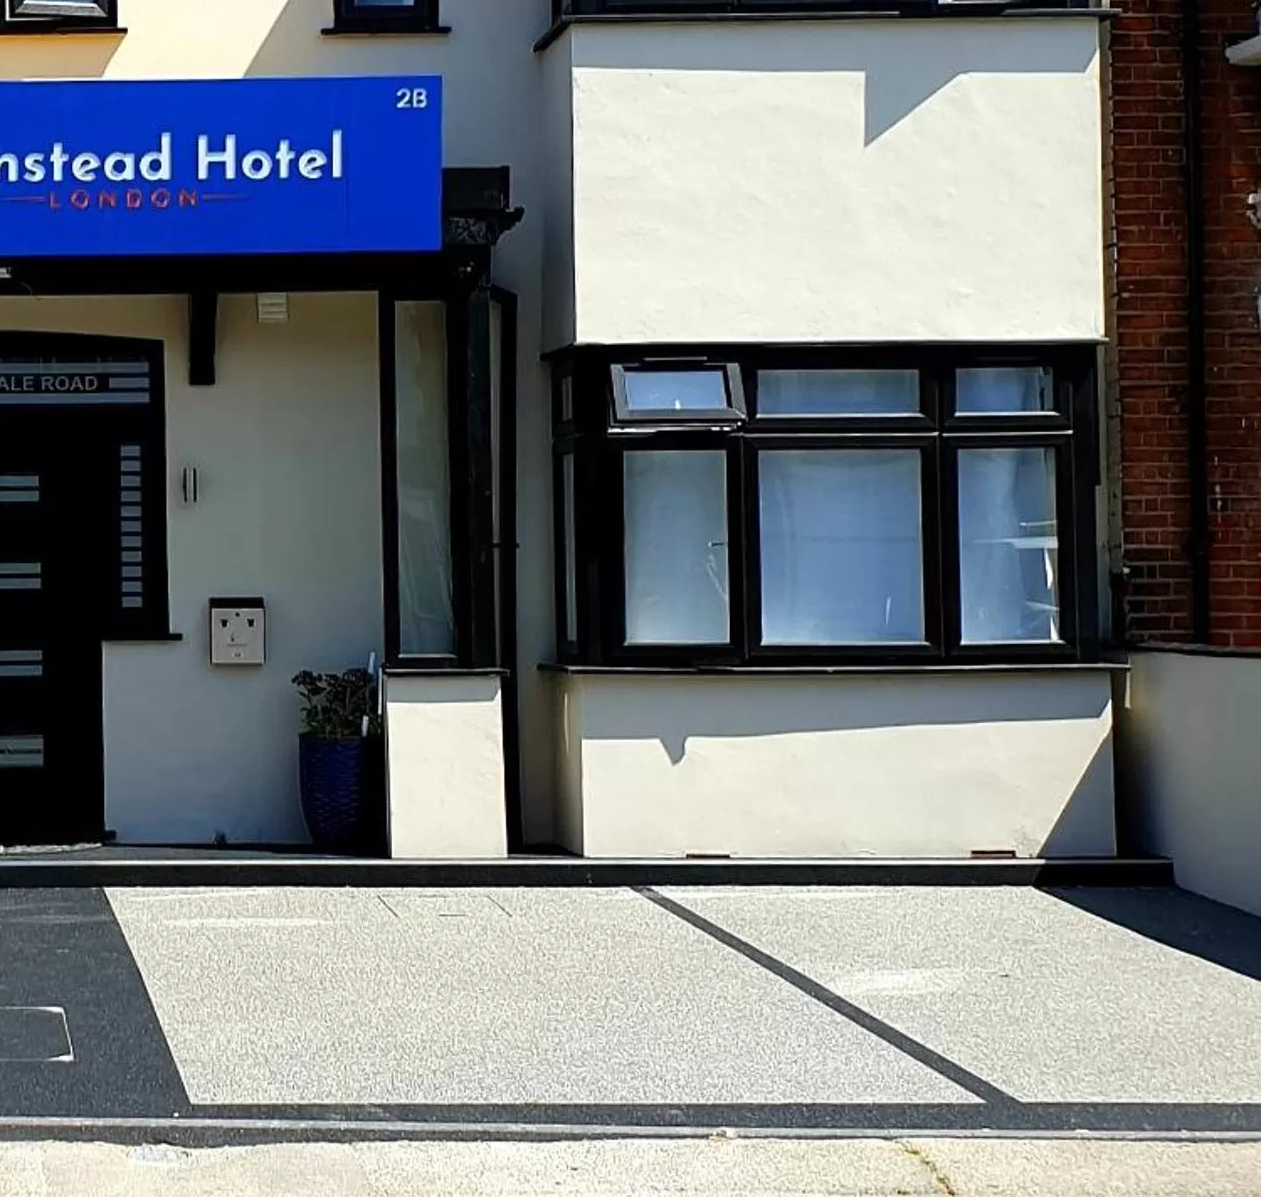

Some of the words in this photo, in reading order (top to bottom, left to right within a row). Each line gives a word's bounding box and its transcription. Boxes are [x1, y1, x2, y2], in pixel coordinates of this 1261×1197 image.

[396, 88, 428, 109] 2B
[197, 129, 343, 181] Hotel
[49, 188, 197, 210] LONDON
[41, 375, 99, 391] ROAD
